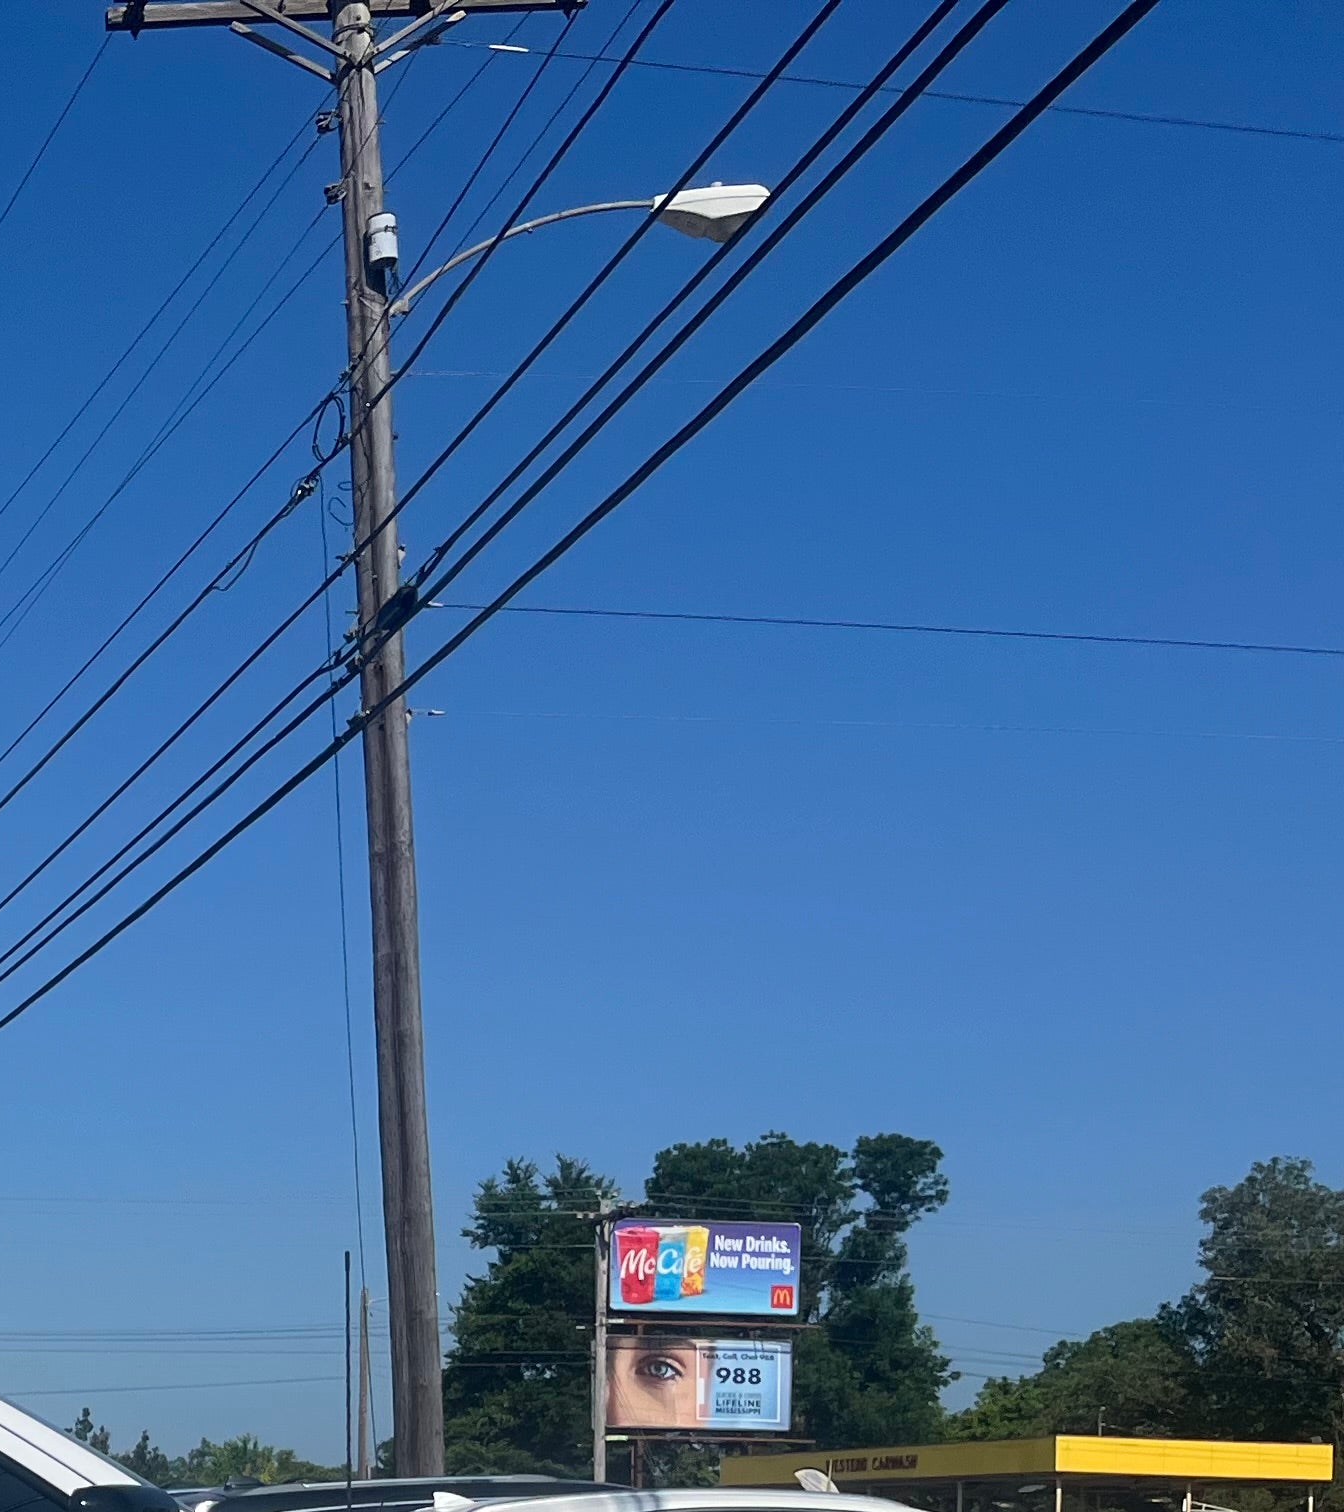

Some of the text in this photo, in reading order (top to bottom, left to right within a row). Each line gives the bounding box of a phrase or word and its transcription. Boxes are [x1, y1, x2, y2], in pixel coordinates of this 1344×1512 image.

[715, 1234, 791, 1253] New Drinks.
[620, 1246, 703, 1280] McCafé
[710, 1252, 795, 1275] Now Pouring.
[716, 1367, 762, 1385] 988
[716, 1399, 761, 1408] LIFELINE
[716, 1407, 761, 1416] MISSISSIPPI
